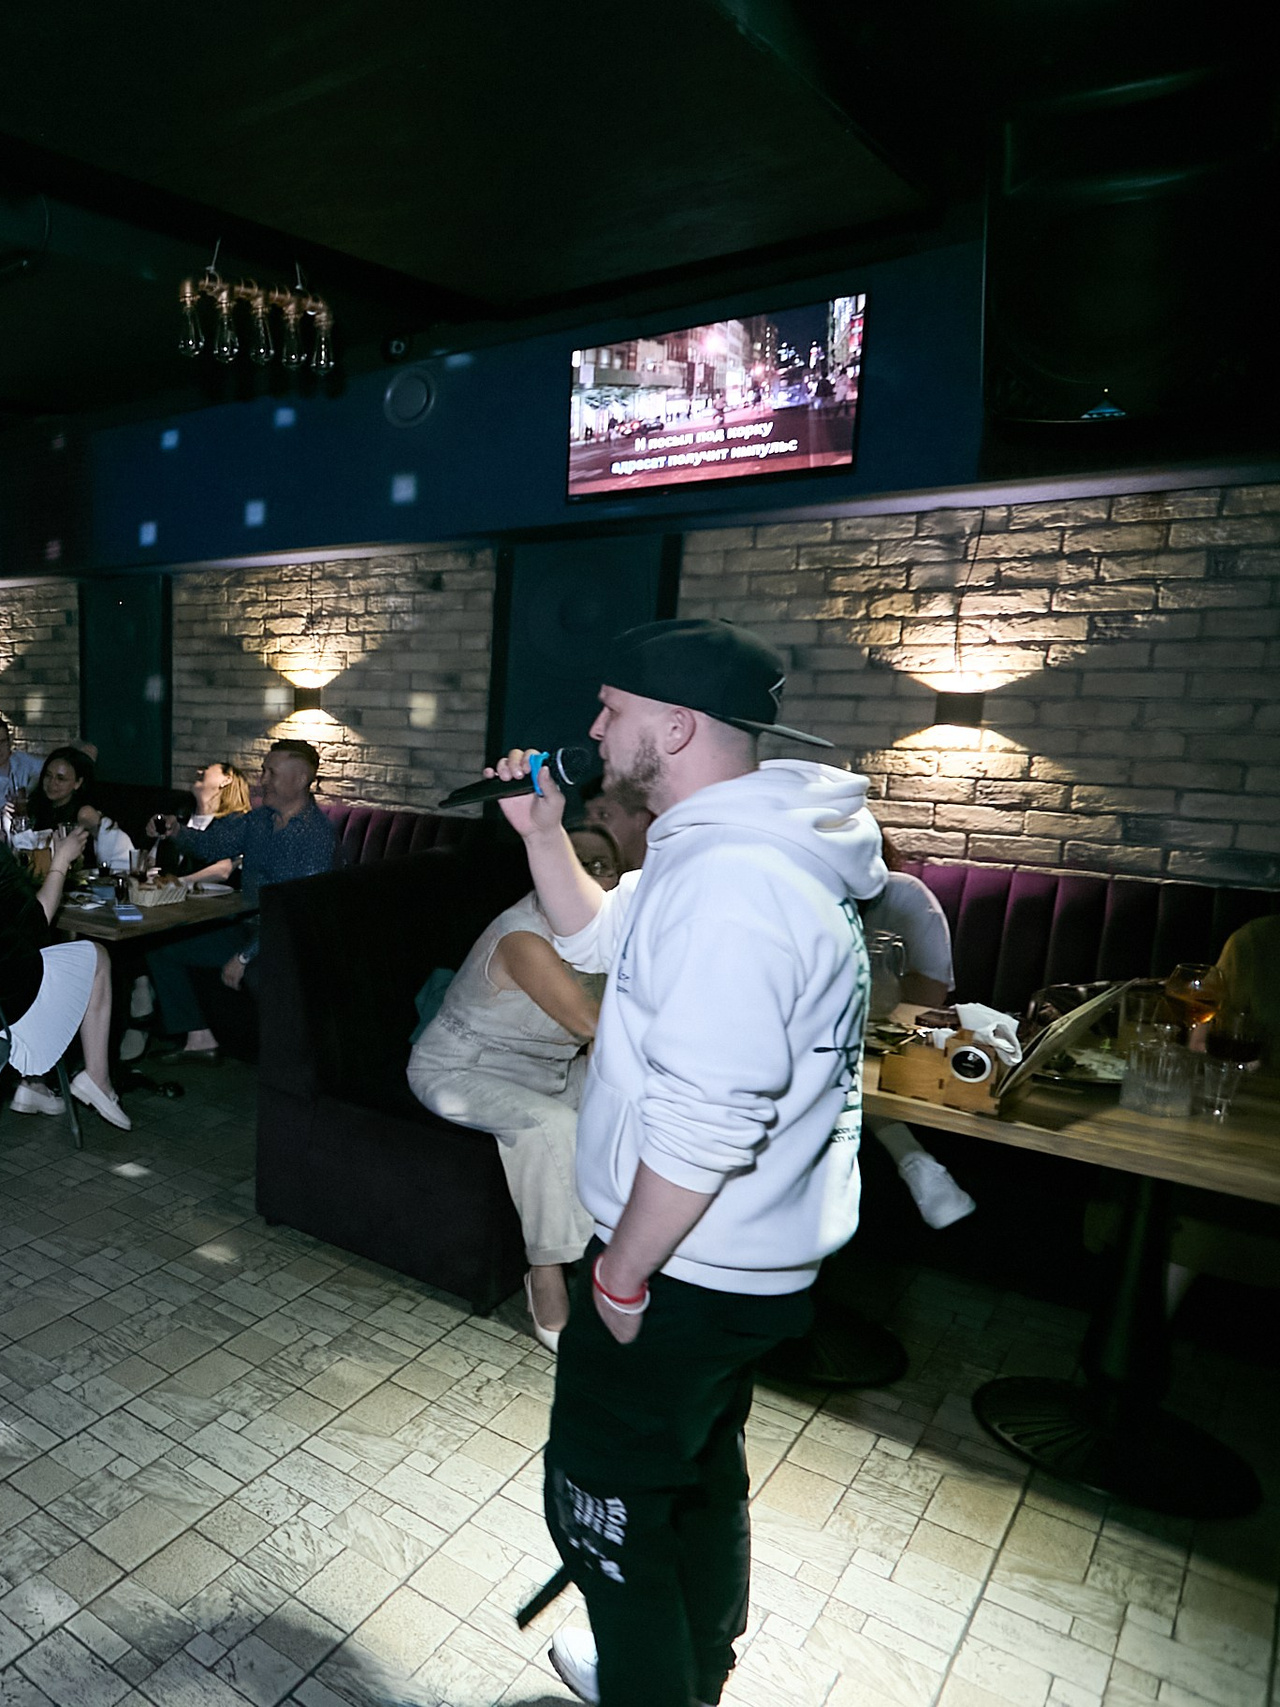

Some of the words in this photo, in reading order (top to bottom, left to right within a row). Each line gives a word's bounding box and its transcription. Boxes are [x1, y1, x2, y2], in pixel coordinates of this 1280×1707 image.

[635, 437, 646, 452] И
[648, 433, 693, 450] посыл
[696, 428, 725, 443] под
[727, 421, 774, 440] корку
[611, 456, 666, 475] адресат
[668, 448, 729, 466] получит
[731, 439, 798, 459] импульс
